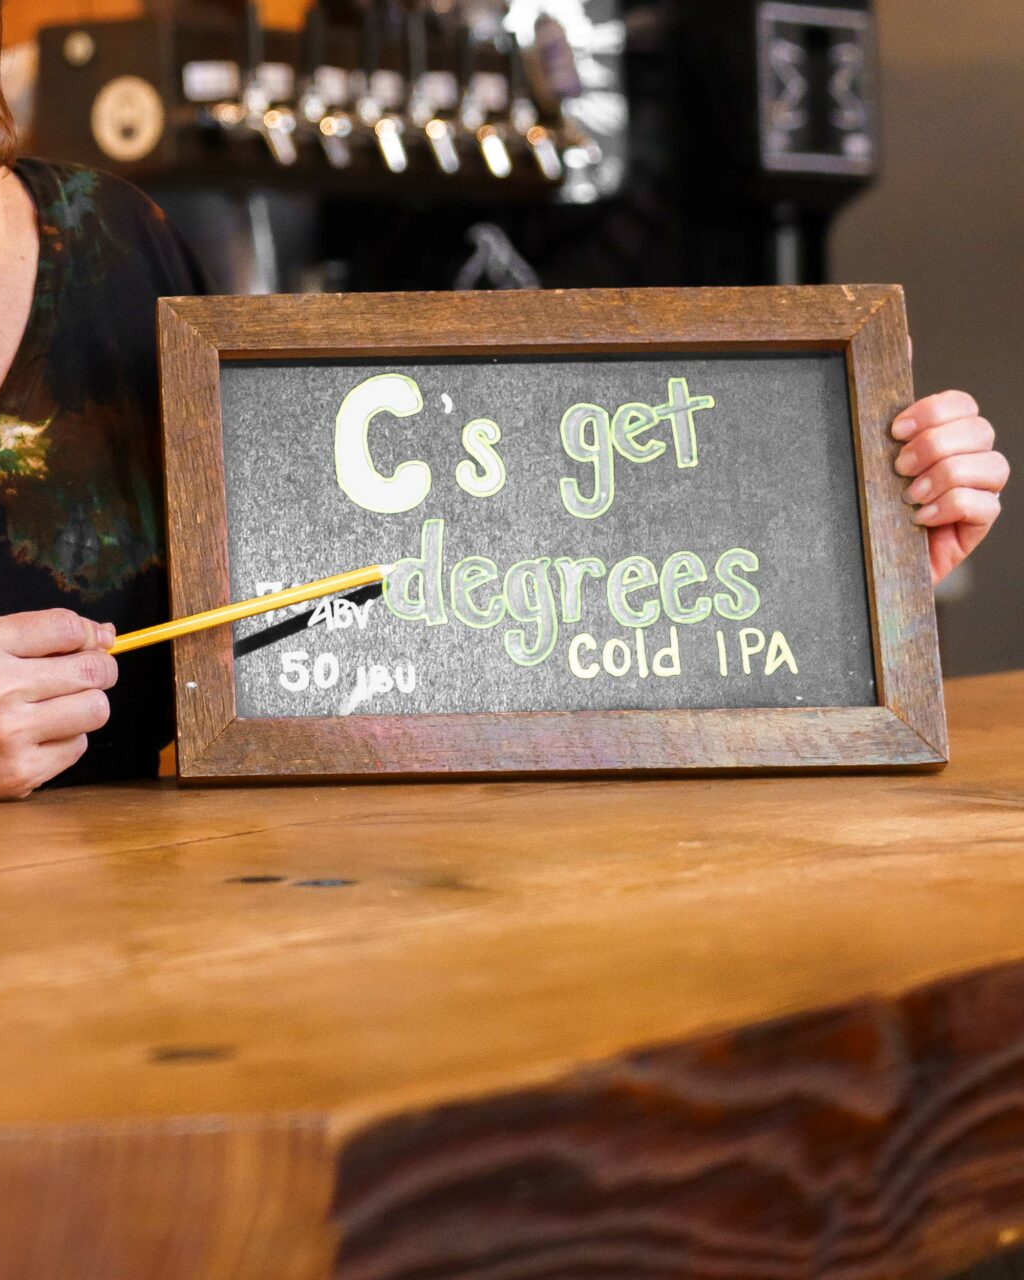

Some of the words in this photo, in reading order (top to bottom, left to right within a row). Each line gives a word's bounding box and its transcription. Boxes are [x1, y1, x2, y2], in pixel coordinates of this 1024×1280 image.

[334, 373, 506, 514] C's
[560, 377, 715, 519] get
[307, 597, 374, 631] ABV
[382, 518, 762, 666] degrees
[278, 650, 340, 692] 50
[716, 628, 798, 677] IPA
